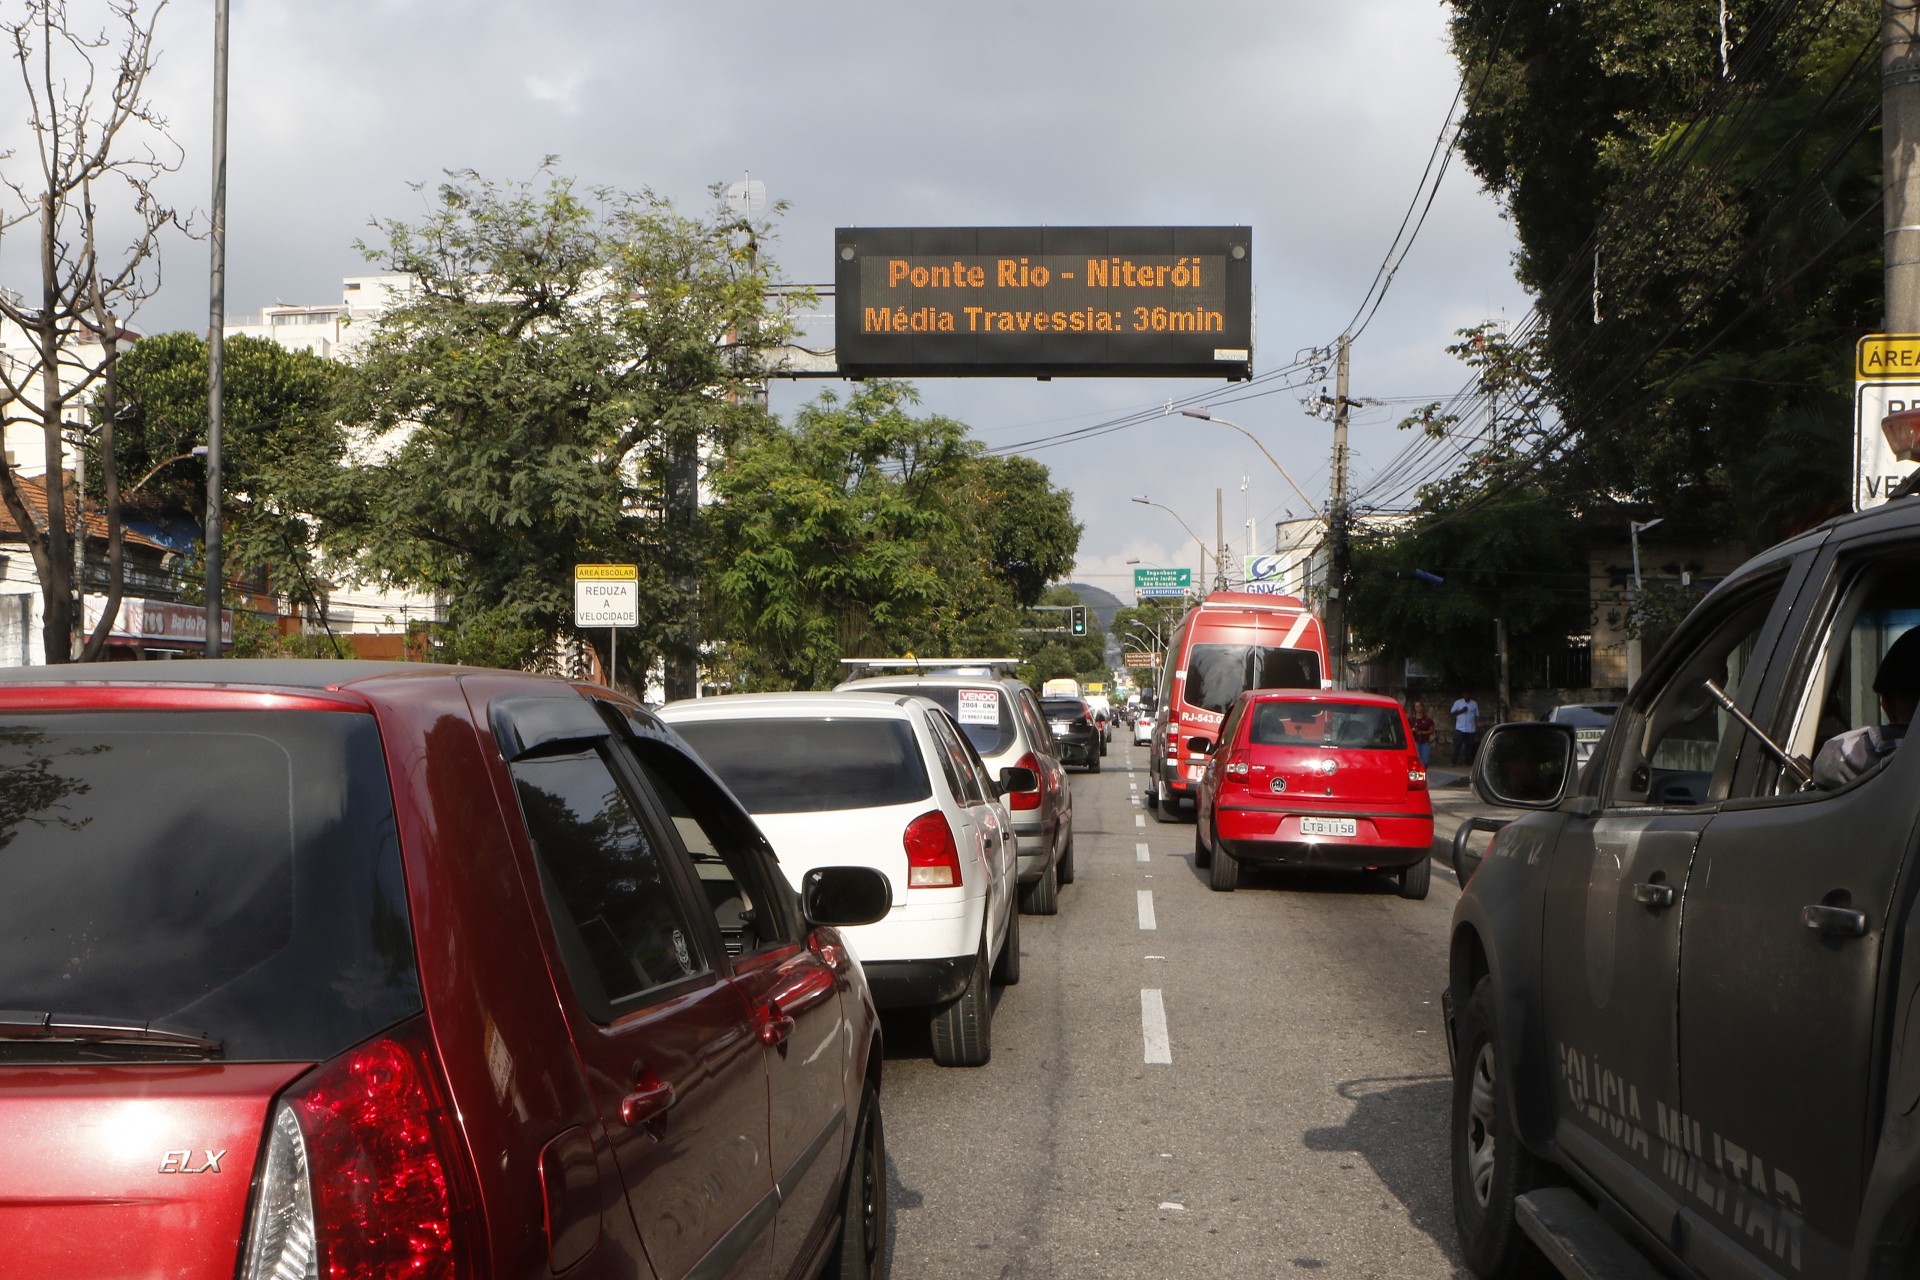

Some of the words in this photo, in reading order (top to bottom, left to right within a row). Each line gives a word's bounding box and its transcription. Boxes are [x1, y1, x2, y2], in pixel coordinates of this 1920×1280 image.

[889, 260, 985, 288] Ponte
[997, 258, 1050, 288] Rio
[1087, 257, 1201, 288] Niterói
[865, 305, 955, 332] Média
[964, 307, 1122, 332] Travessia:
[1133, 306, 1223, 332] 36min
[1866, 475, 1909, 498] VE
[586, 586, 627, 595] REDUZA
[1246, 584, 1276, 594] GNV
[603, 599, 610, 608] A
[172, 613, 186, 629] Bar
[185, 615, 196, 629] do
[579, 612, 635, 621] VELOCIDADE
[961, 692, 996, 701] VENDO
[1182, 712, 1224, 725] RJ-543.0
[158, 1149, 227, 1174] ELX
[1656, 1100, 1803, 1272] MILITAR
